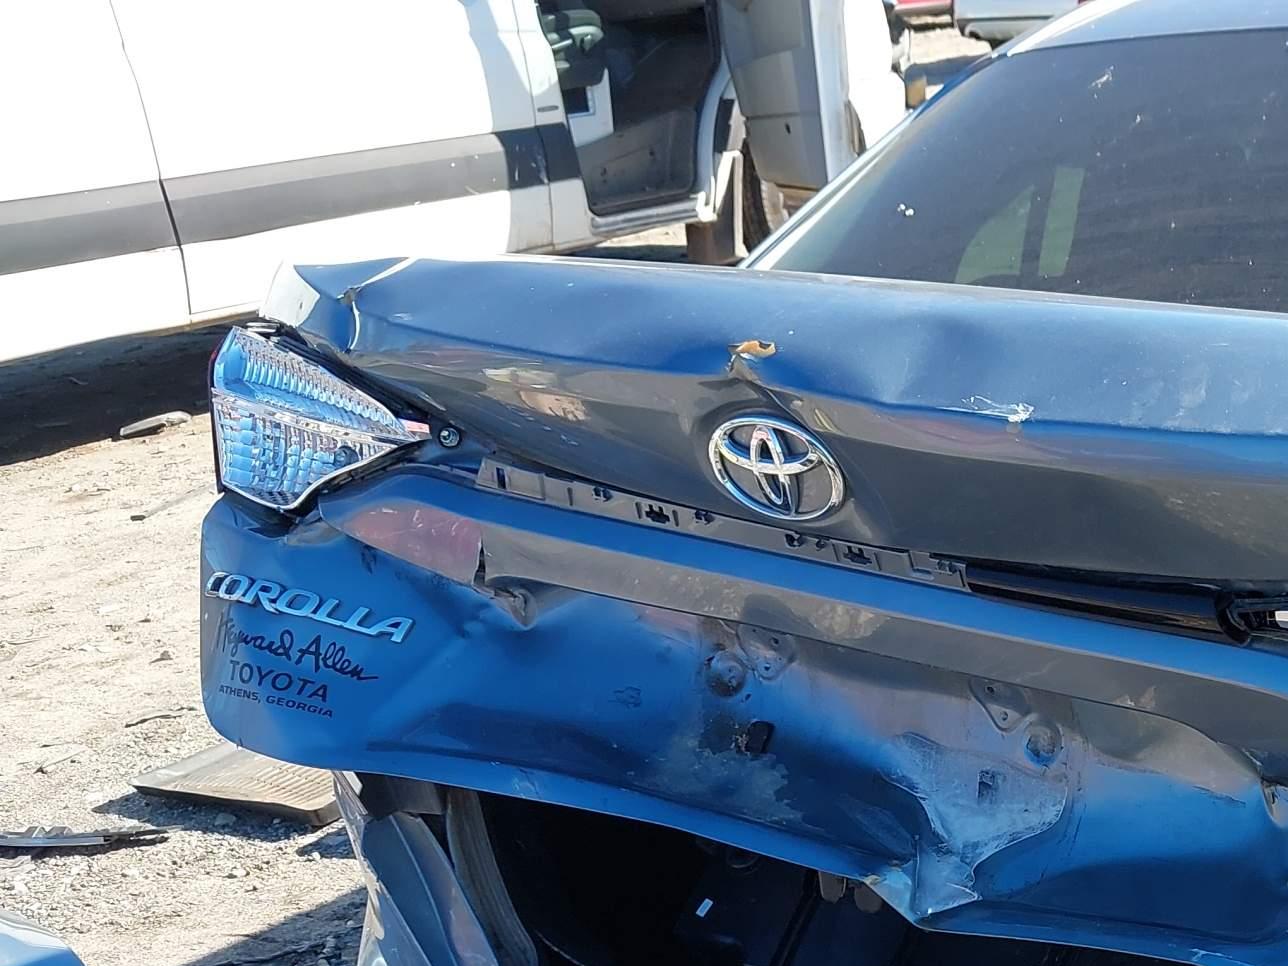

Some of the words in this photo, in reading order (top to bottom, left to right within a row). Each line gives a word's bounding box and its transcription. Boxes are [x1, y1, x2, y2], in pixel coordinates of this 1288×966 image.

[205, 571, 414, 643] COROLLA
[229, 659, 328, 702] TOYOTA
[294, 634, 379, 682] Allen
[219, 684, 261, 704] ATHENS,
[265, 695, 333, 718] GEORGIA
